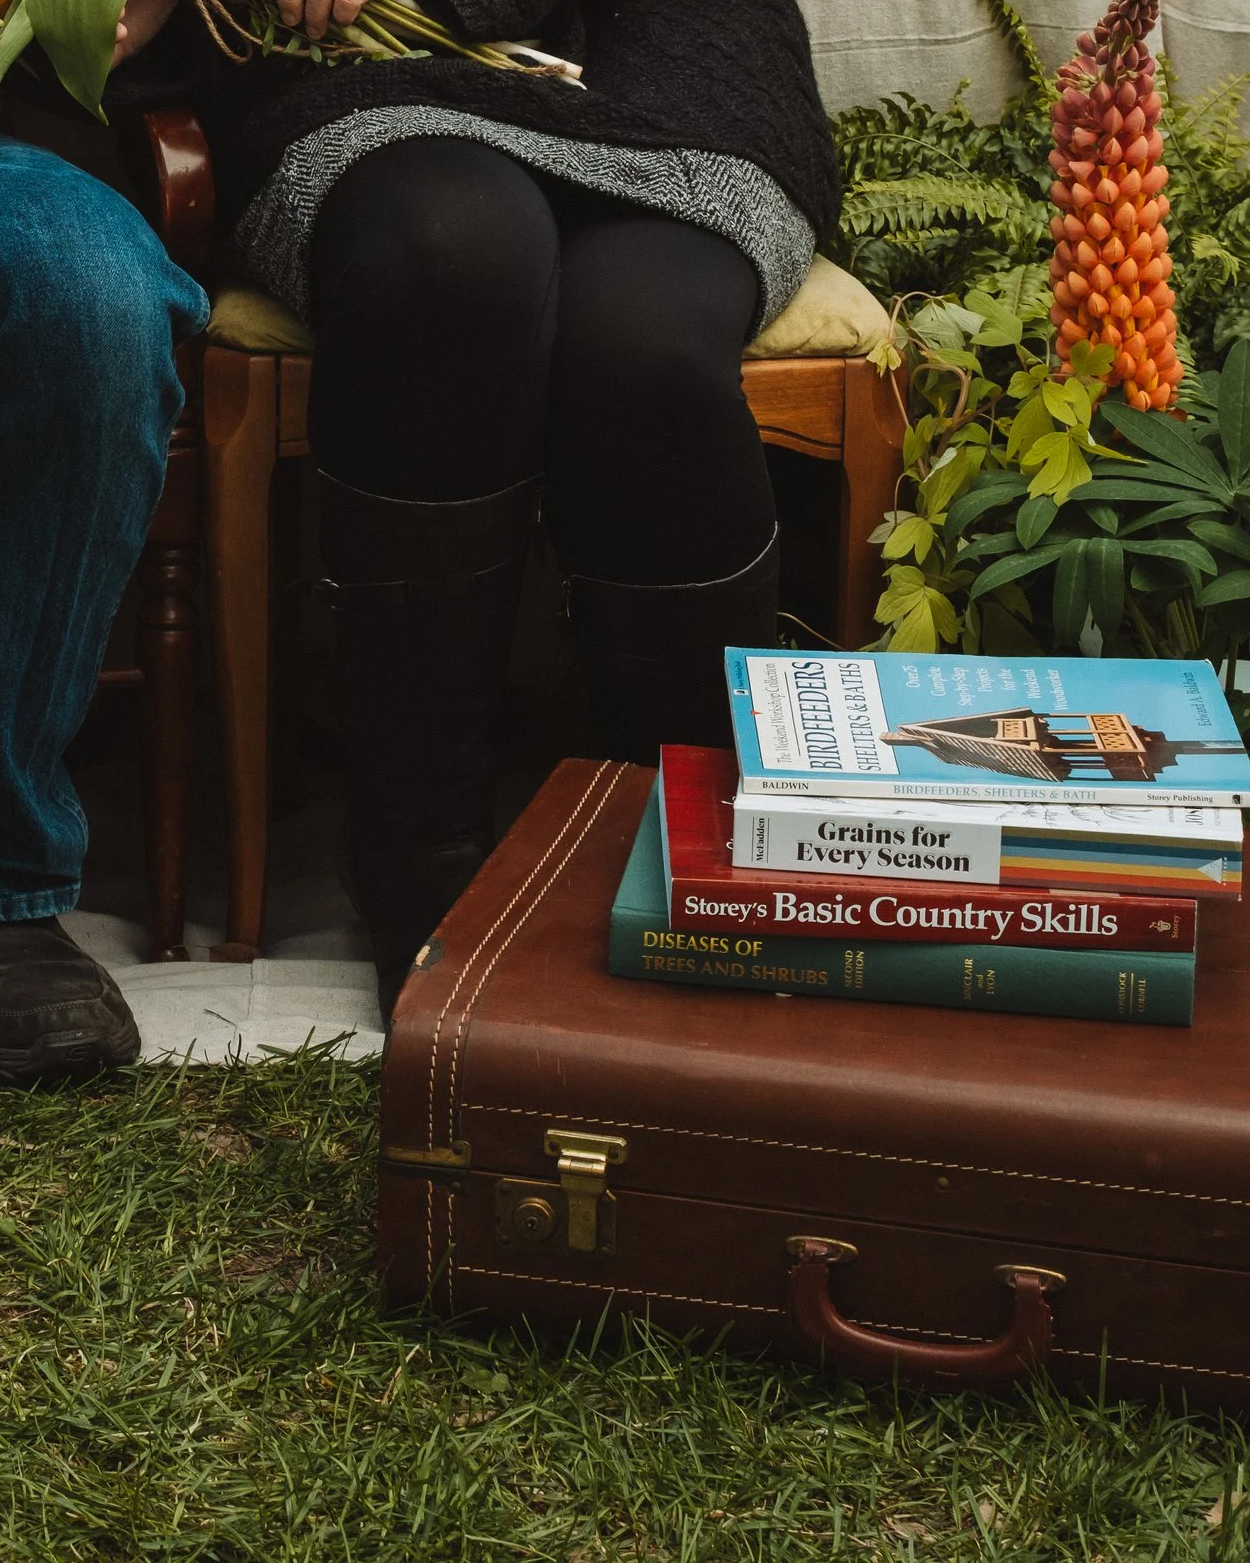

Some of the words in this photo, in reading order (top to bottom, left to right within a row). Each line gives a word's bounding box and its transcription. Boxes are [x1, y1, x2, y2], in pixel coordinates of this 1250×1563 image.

[838, 663, 868, 701] BATHS
[791, 661, 843, 770] BIRDFEEDERS
[847, 702, 868, 713] &
[847, 714, 882, 772] SHELTERS
[762, 781, 809, 790] BALDWIN
[893, 785, 981, 797] BIRDFEEDERS,
[984, 787, 1046, 799] SHELTERS
[1049, 790, 1059, 799] &
[1063, 790, 1096, 800] BATH
[1147, 793, 1170, 802] Storey
[1173, 794, 1214, 803] Publishing
[755, 817, 765, 862] McFadden
[817, 821, 905, 847] Grains
[912, 826, 951, 848] for
[796, 842, 871, 870] Every
[877, 847, 970, 872] Season
[684, 895, 768, 922] Storey's
[772, 892, 862, 925] Basic
[869, 896, 1015, 941] Country
[1020, 902, 1119, 936] Skills
[1171, 914, 1181, 939] Storey
[642, 931, 730, 955] DISEASES
[734, 939, 763, 957] OF
[641, 955, 696, 974] TREES
[701, 961, 746, 979] AND
[751, 965, 829, 986] SHRUBS
[844, 949, 854, 988] SECOND
[854, 950, 865, 989] EDITION
[963, 957, 974, 1000] SINCLAIR
[975, 974, 984, 989] and
[986, 968, 996, 995] LYON
